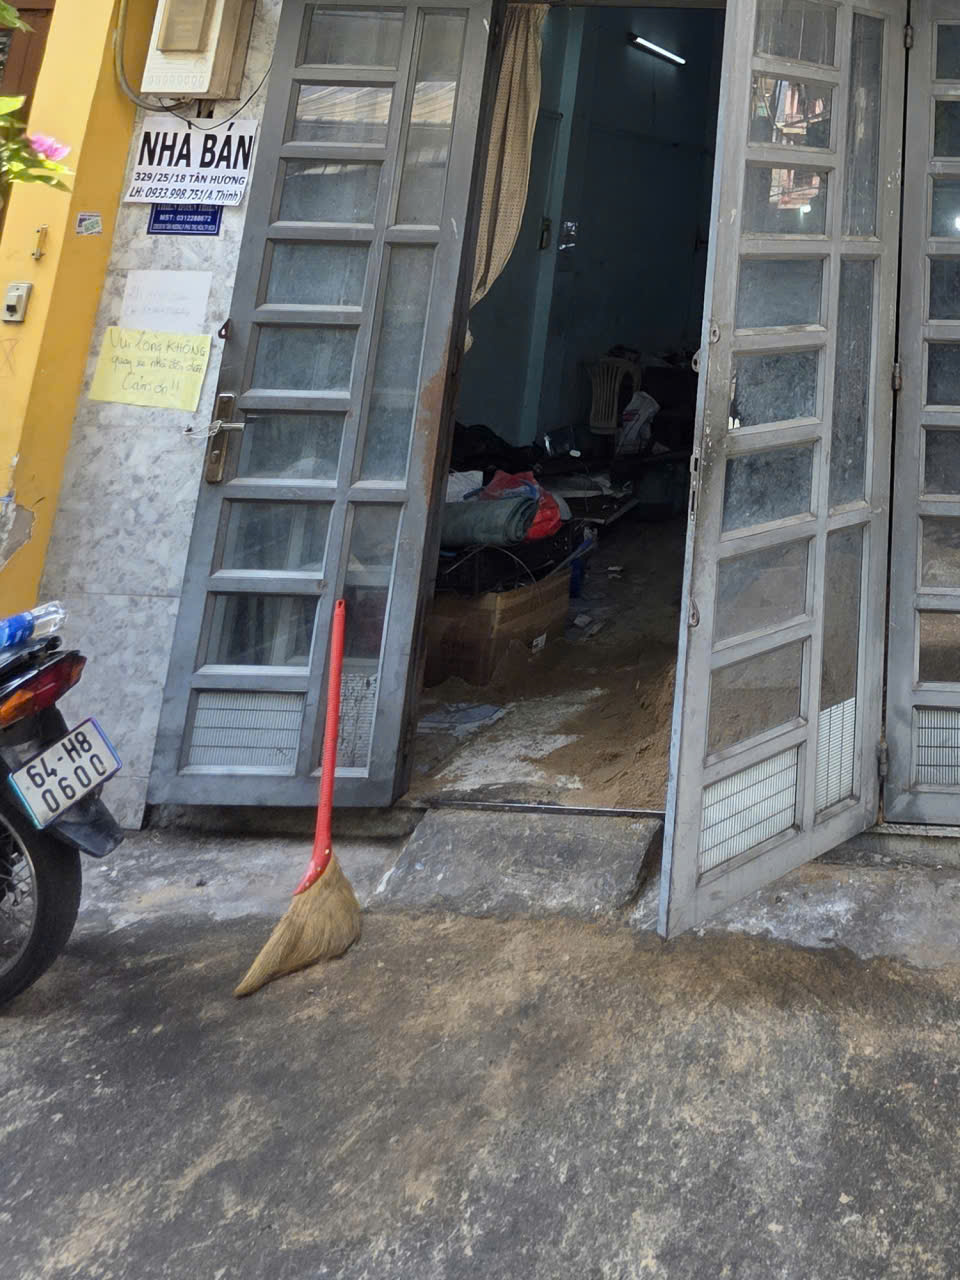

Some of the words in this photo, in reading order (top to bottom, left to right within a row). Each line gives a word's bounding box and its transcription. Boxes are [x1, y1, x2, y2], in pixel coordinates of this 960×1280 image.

[138, 120, 191, 168] NHÀ
[199, 122, 253, 170] BÁN
[134, 172, 186, 184] 329/25/18
[188, 173, 208, 184] TÂN
[209, 175, 246, 186] HƯƠNG
[129, 186, 144, 198] LH:
[167, 339, 207, 356] KHÔNG
[25, 730, 92, 789] 64-H8
